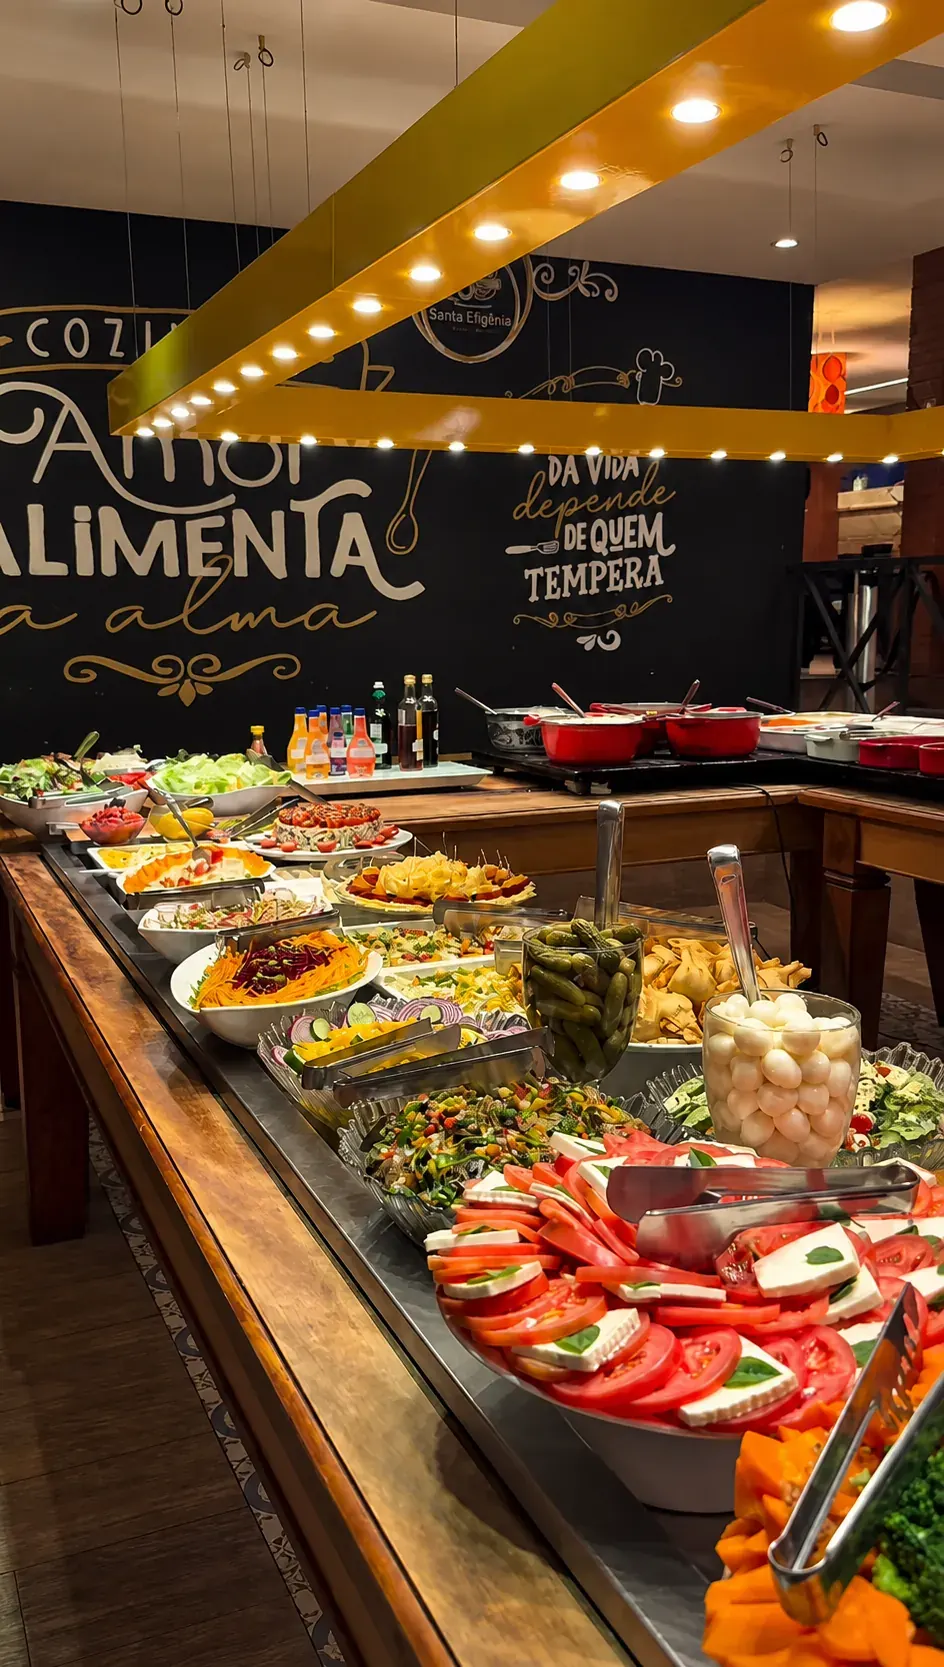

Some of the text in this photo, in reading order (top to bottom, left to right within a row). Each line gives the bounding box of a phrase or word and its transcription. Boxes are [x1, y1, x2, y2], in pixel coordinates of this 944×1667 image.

[26, 317, 178, 358] COZI
[429, 307, 512, 328] Santa Efigênia
[547, 455, 640, 487] DA VIDA
[512, 460, 676, 539] depende
[564, 511, 676, 556] DE QUEM
[105, 555, 378, 635] alma
[524, 554, 664, 603] TEMPERA
